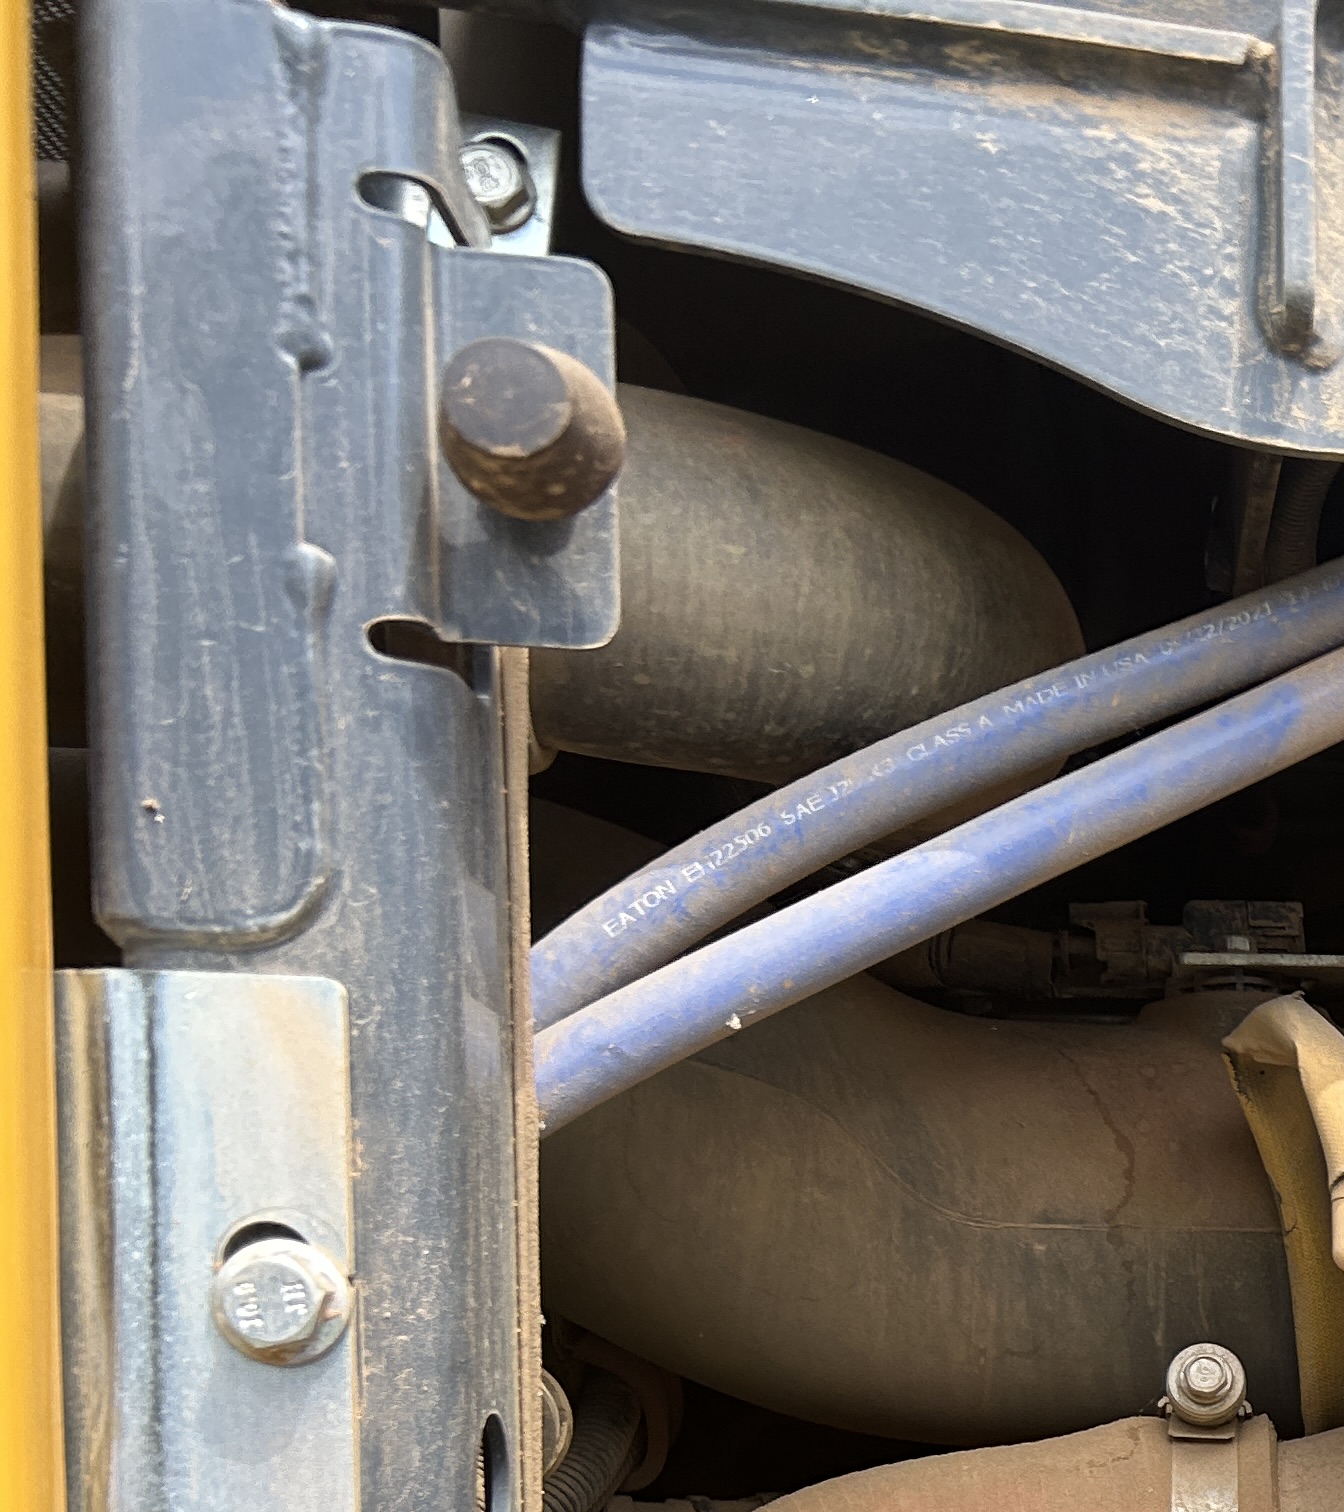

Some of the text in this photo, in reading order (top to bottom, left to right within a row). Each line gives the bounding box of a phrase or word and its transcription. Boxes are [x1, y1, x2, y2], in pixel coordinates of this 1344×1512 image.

[602, 879, 678, 938] EATON
[779, 790, 827, 827] SAE
[905, 721, 973, 762] CLASS
[977, 714, 994, 731] A
[1001, 681, 1069, 719] MADE
[1072, 669, 1097, 690] IN
